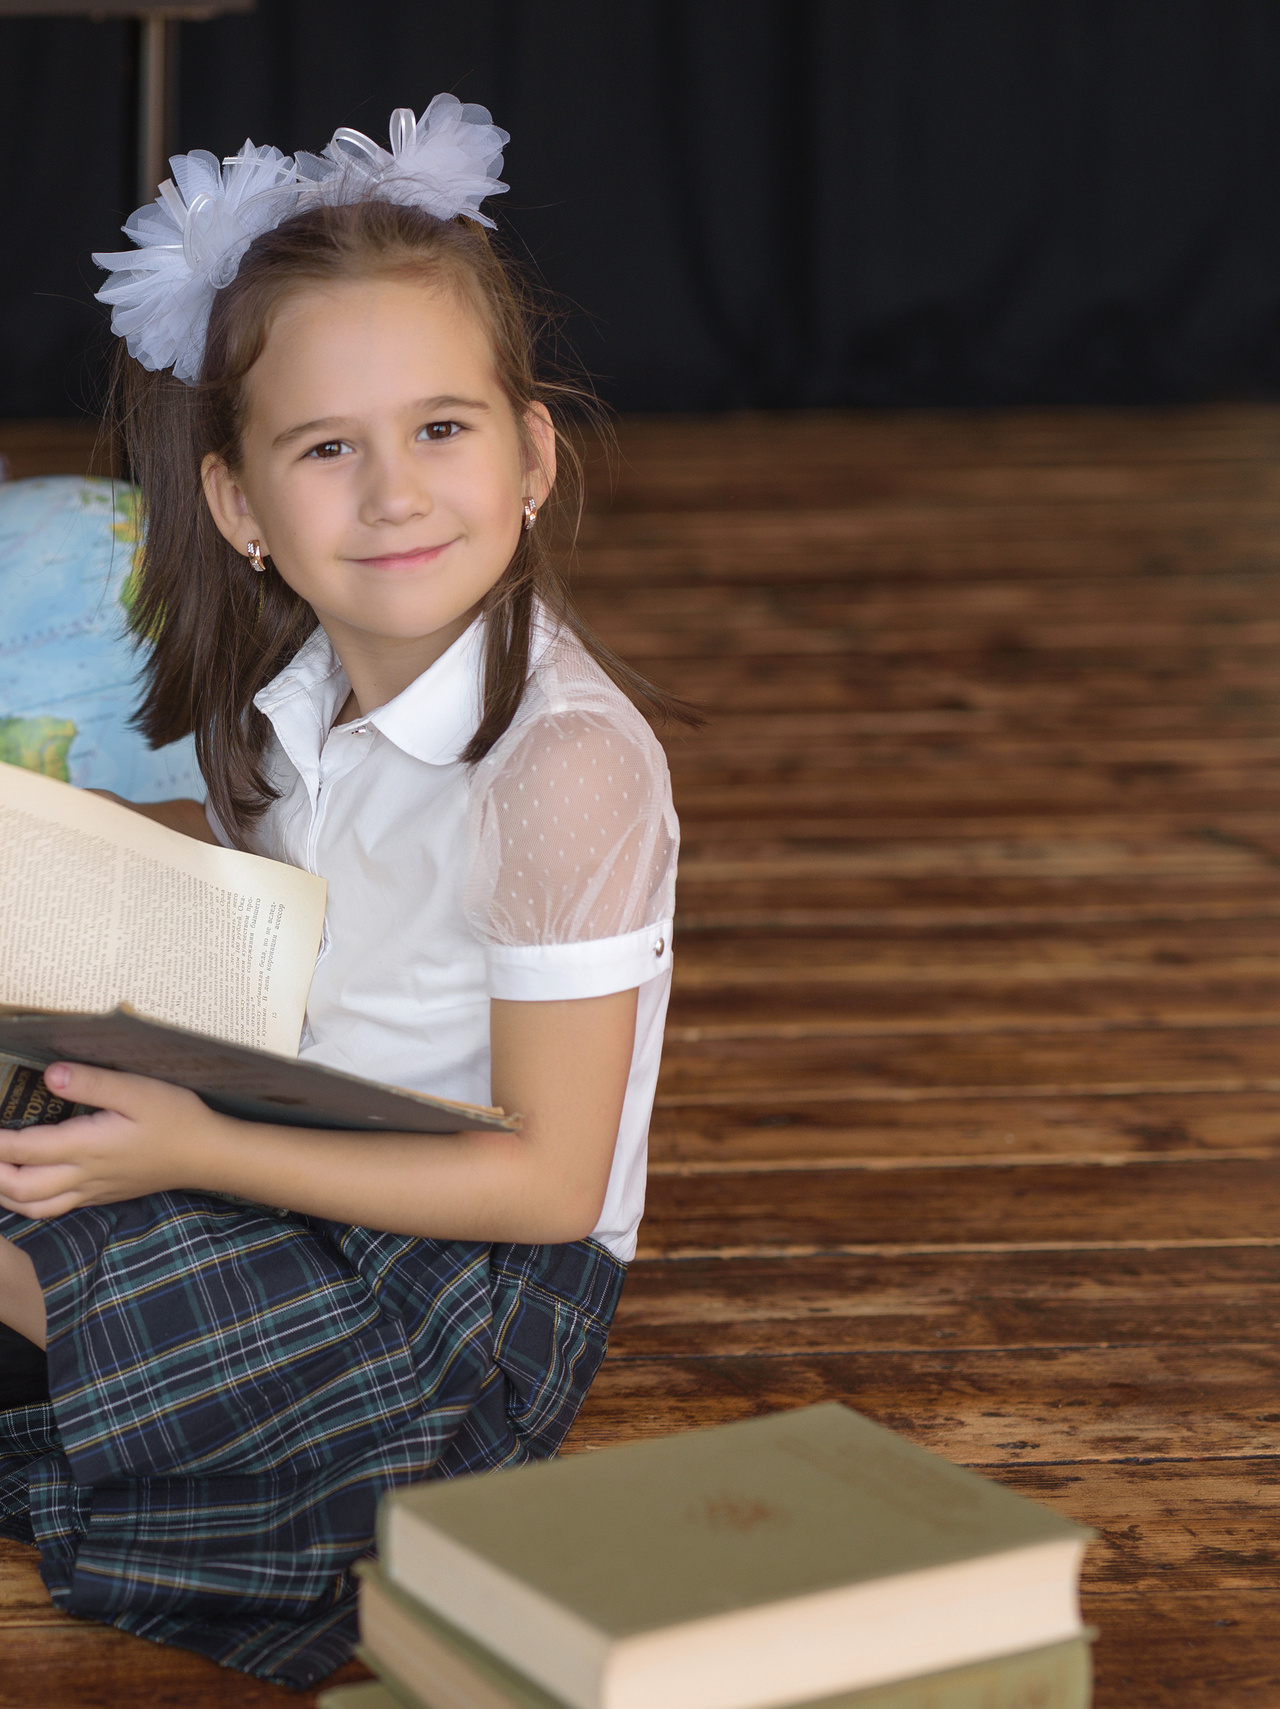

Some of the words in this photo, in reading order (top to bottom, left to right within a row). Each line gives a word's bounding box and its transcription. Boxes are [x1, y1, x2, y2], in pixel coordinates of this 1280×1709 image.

[236, 893, 246, 912] Ока-
[266, 900, 277, 924] вслед-
[249, 897, 261, 929] бывшего
[264, 926, 271, 935] не
[265, 933, 277, 972] коронации
[273, 902, 286, 930] асессор
[262, 936, 269, 947] но
[257, 949, 268, 968] беда,
